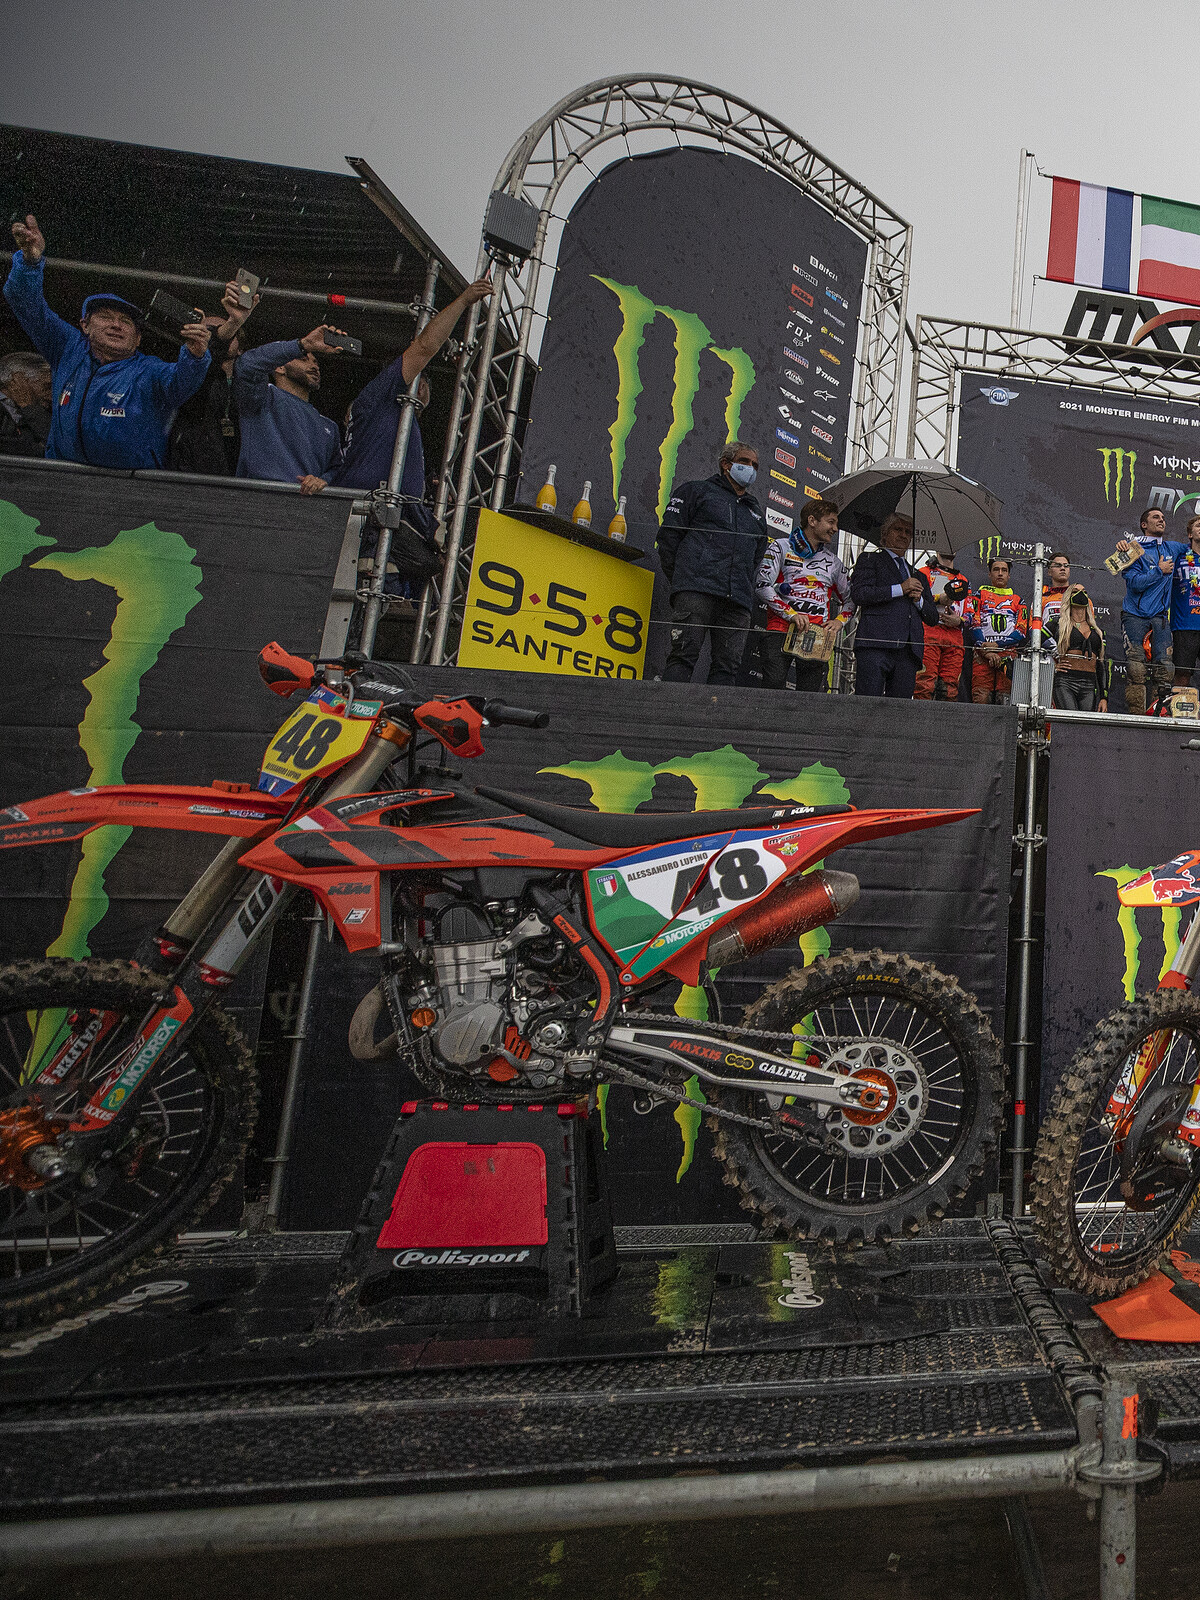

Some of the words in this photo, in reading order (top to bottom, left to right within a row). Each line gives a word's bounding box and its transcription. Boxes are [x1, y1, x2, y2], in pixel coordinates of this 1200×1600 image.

[786, 320, 812, 342] FOX
[821, 371, 840, 387] THOR
[1059, 401, 1083, 411] 2021
[1086, 404, 1132, 418] MONSTER
[1133, 411, 1171, 424] ENERGY
[1173, 416, 1189, 426] FIM
[811, 469, 831, 484] ATHENA
[272, 712, 343, 770] 48
[790, 807, 815, 816] KTM
[627, 861, 680, 882] ALESSANDRO
[680, 853, 709, 866] LUPINO
[327, 882, 372, 896] KTM
[670, 848, 769, 917] 48
[665, 917, 715, 944] MOTOREX
[855, 974, 901, 985] MAXXIS
[51, 1019, 103, 1079] GALFER
[120, 1021, 177, 1087] MOTOREX
[669, 1039, 723, 1061] MAXXIS
[758, 1062, 808, 1082] GALFER
[395, 1249, 530, 1268] Polisport
